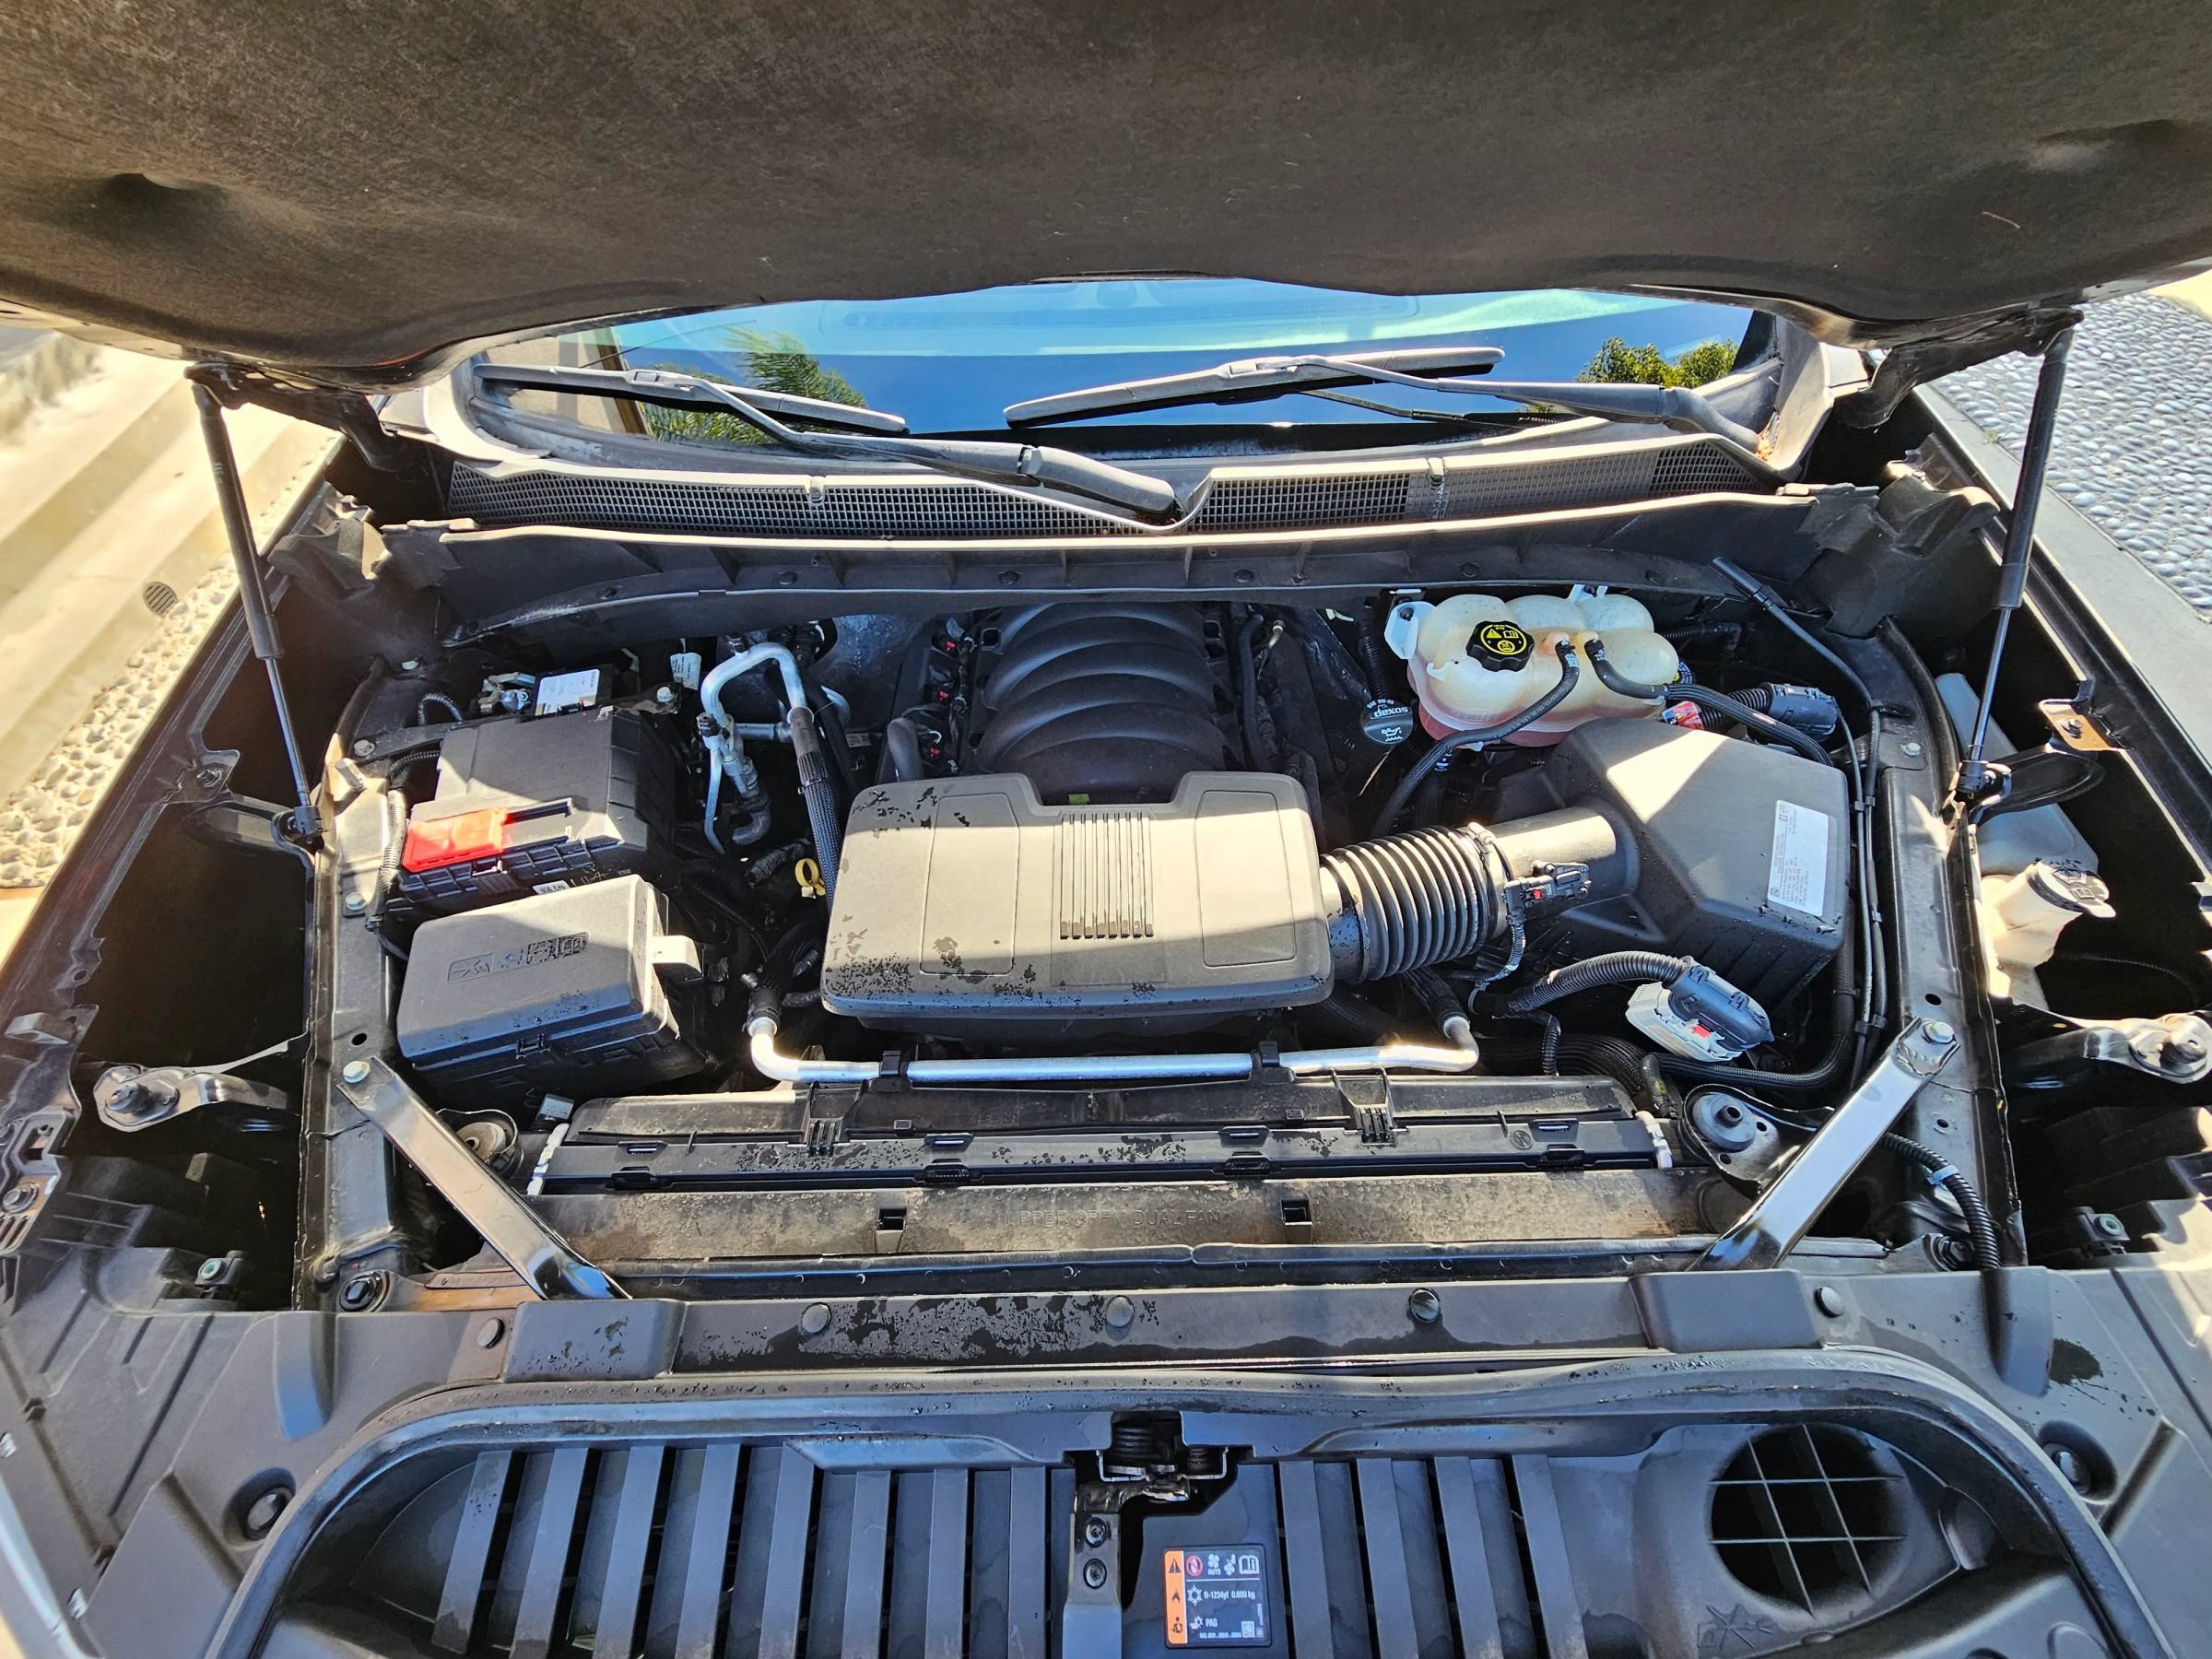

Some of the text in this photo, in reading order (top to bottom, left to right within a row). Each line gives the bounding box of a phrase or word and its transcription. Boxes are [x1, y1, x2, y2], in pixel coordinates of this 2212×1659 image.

[1374, 706, 1408, 717] dexos
[1006, 1210, 1068, 1226] UPPER
[1133, 1209, 1181, 1225] DUAL
[1186, 1209, 1220, 1224] FAN
[1206, 1618, 1218, 1627] PAG
